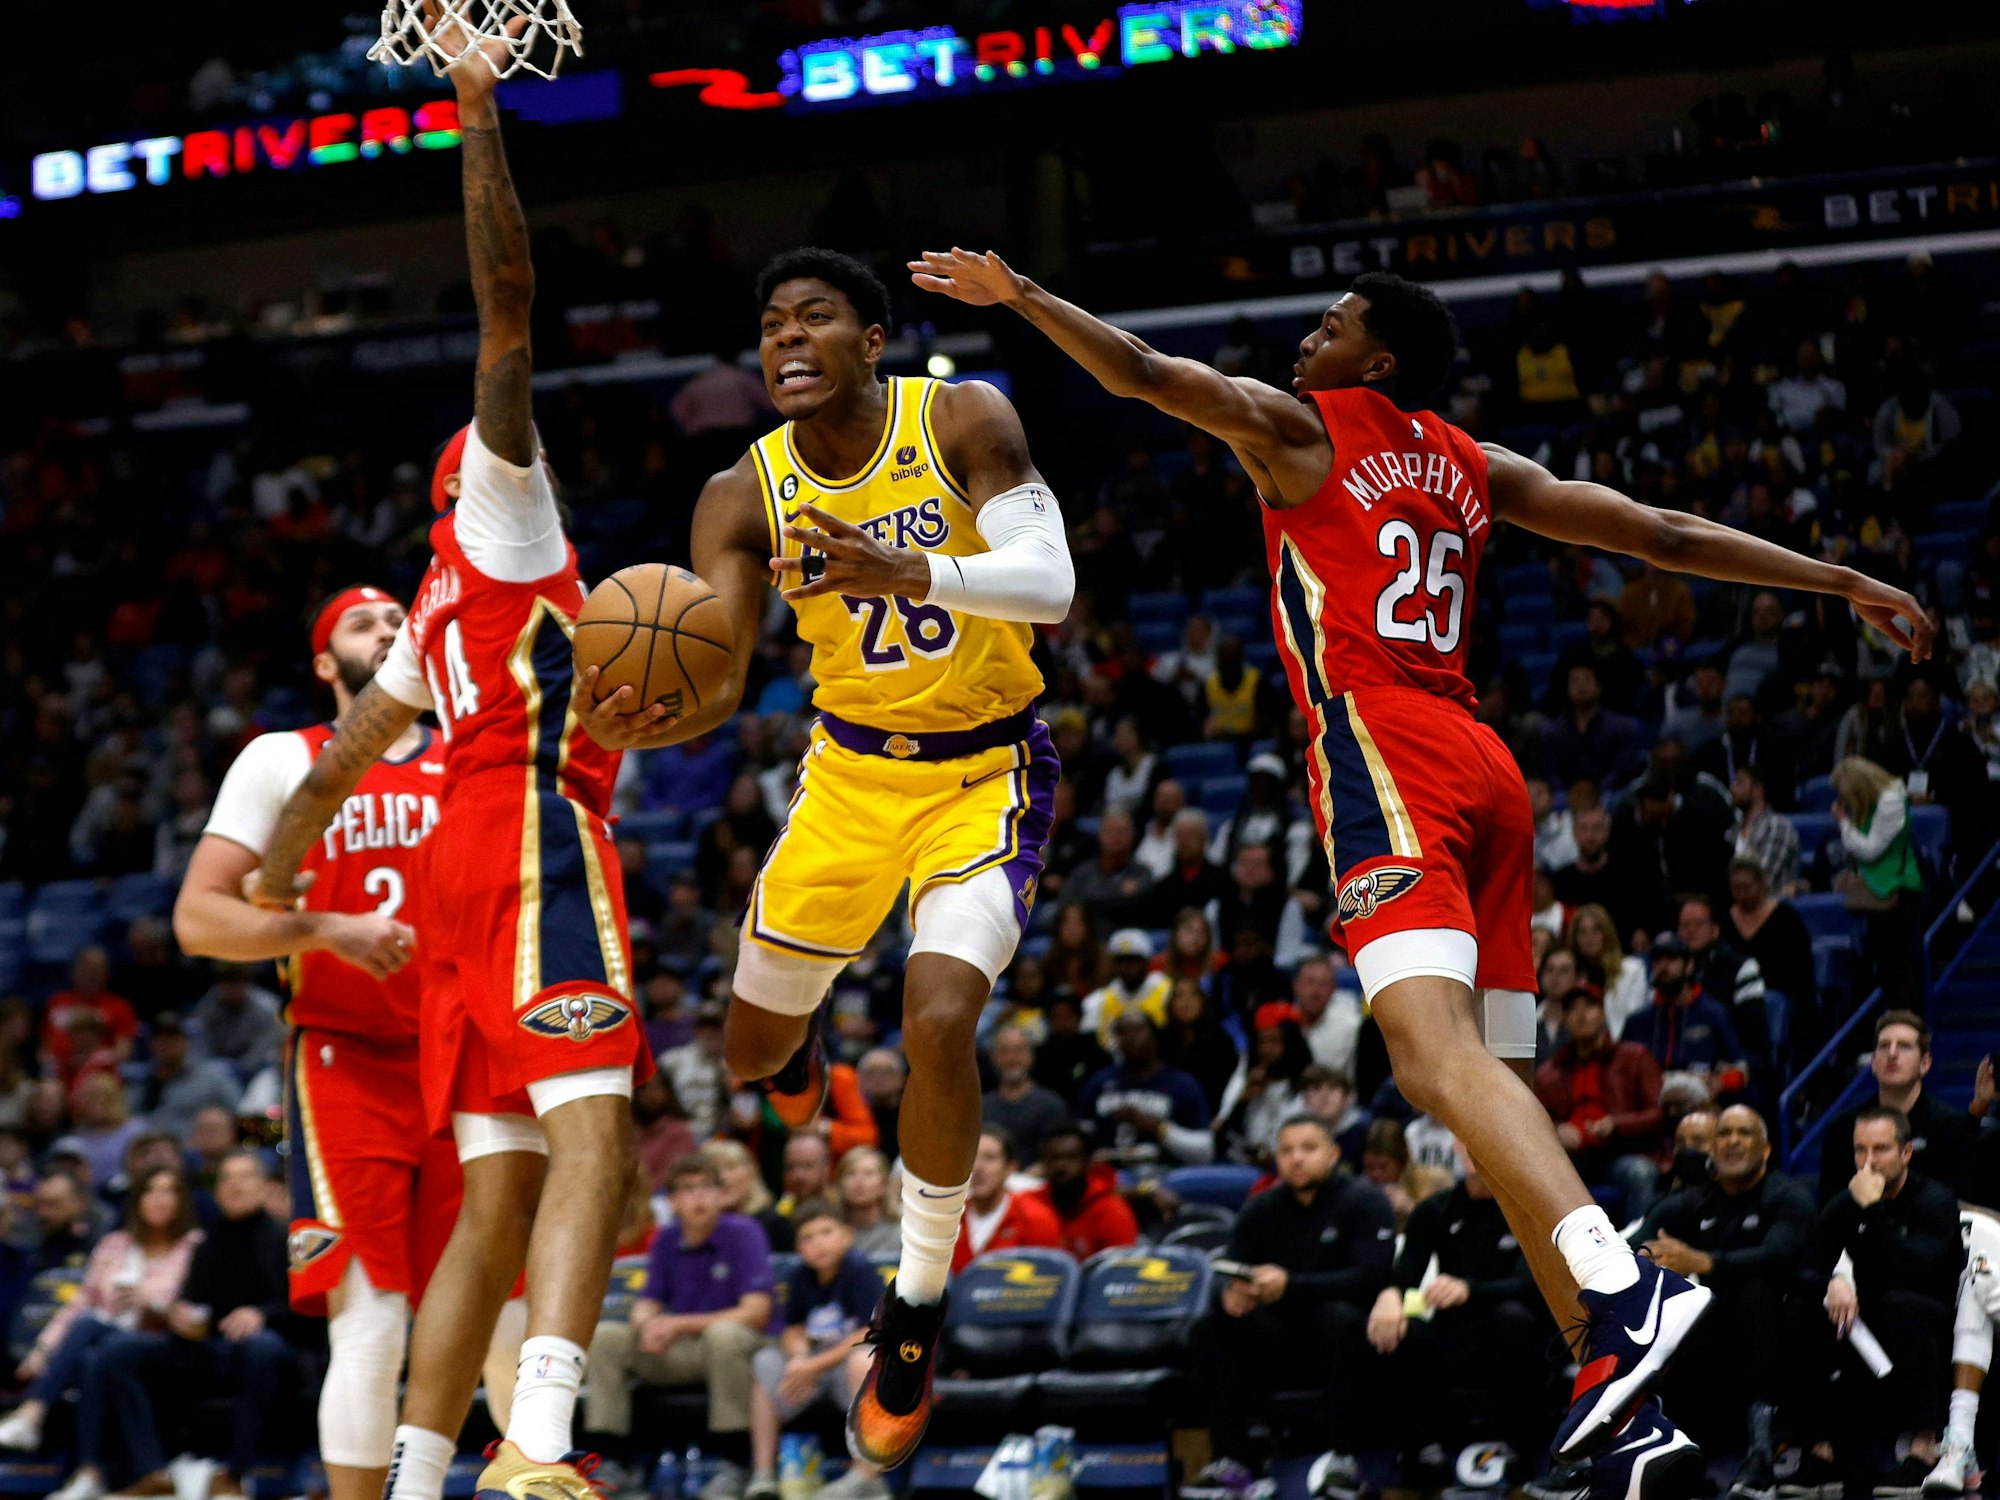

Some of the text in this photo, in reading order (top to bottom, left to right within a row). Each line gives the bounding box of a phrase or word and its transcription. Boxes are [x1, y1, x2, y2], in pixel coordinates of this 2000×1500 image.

[31, 99, 463, 201] BETRIVERS
[1288, 214, 1618, 280] BETRIVERS
[782, 475, 796, 500] 6
[890, 462, 929, 482] bibigo
[1341, 450, 1489, 537] MURPHY III
[1375, 516, 1466, 656] 25
[840, 592, 961, 673] 28
[364, 865, 406, 919] 2
